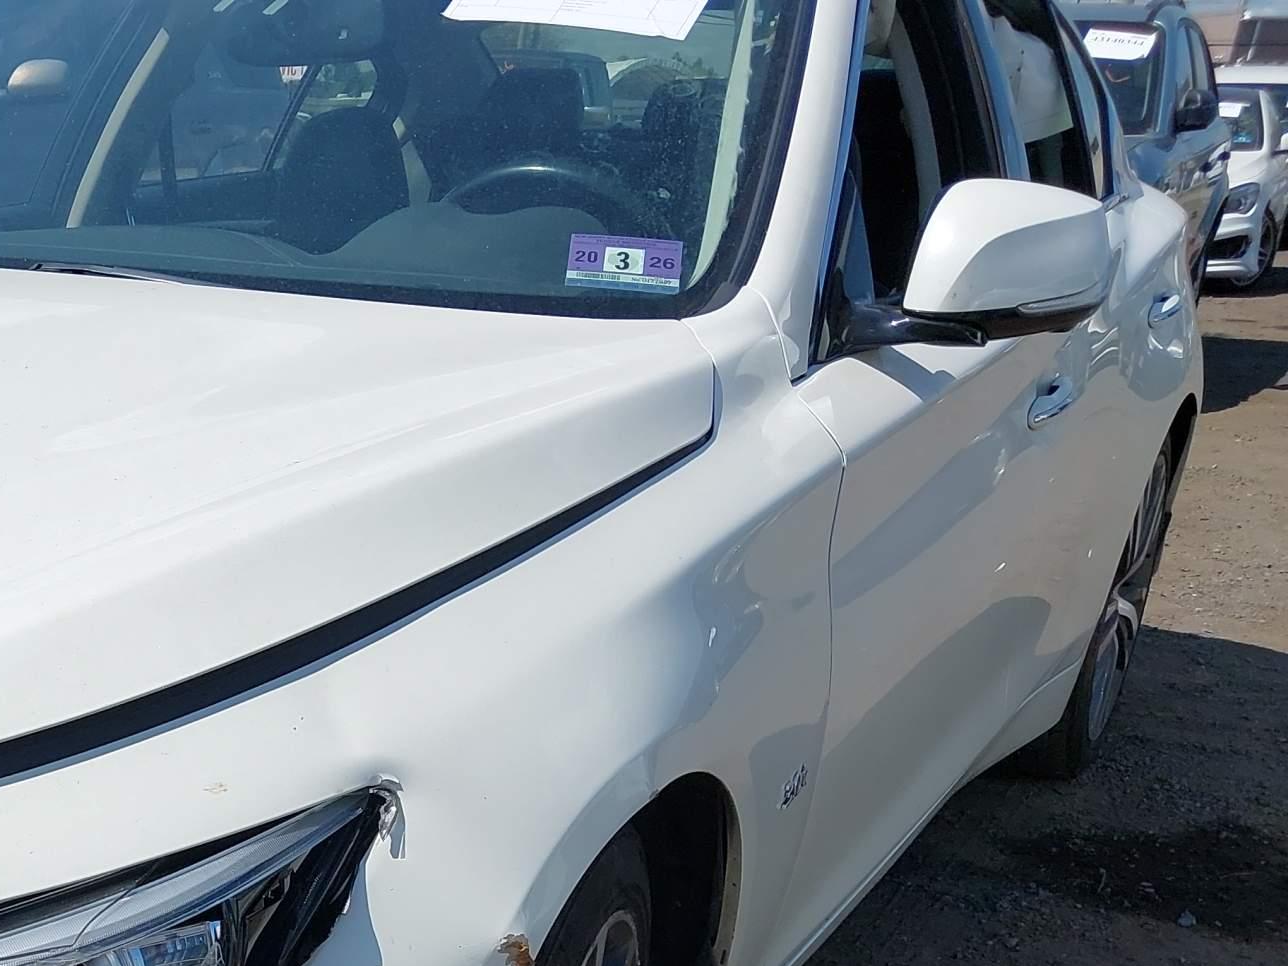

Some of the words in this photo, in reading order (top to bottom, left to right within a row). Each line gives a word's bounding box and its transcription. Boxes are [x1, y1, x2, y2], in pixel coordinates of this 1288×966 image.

[574, 250, 599, 264] 20
[614, 251, 630, 270] 3
[649, 256, 675, 270] 26
